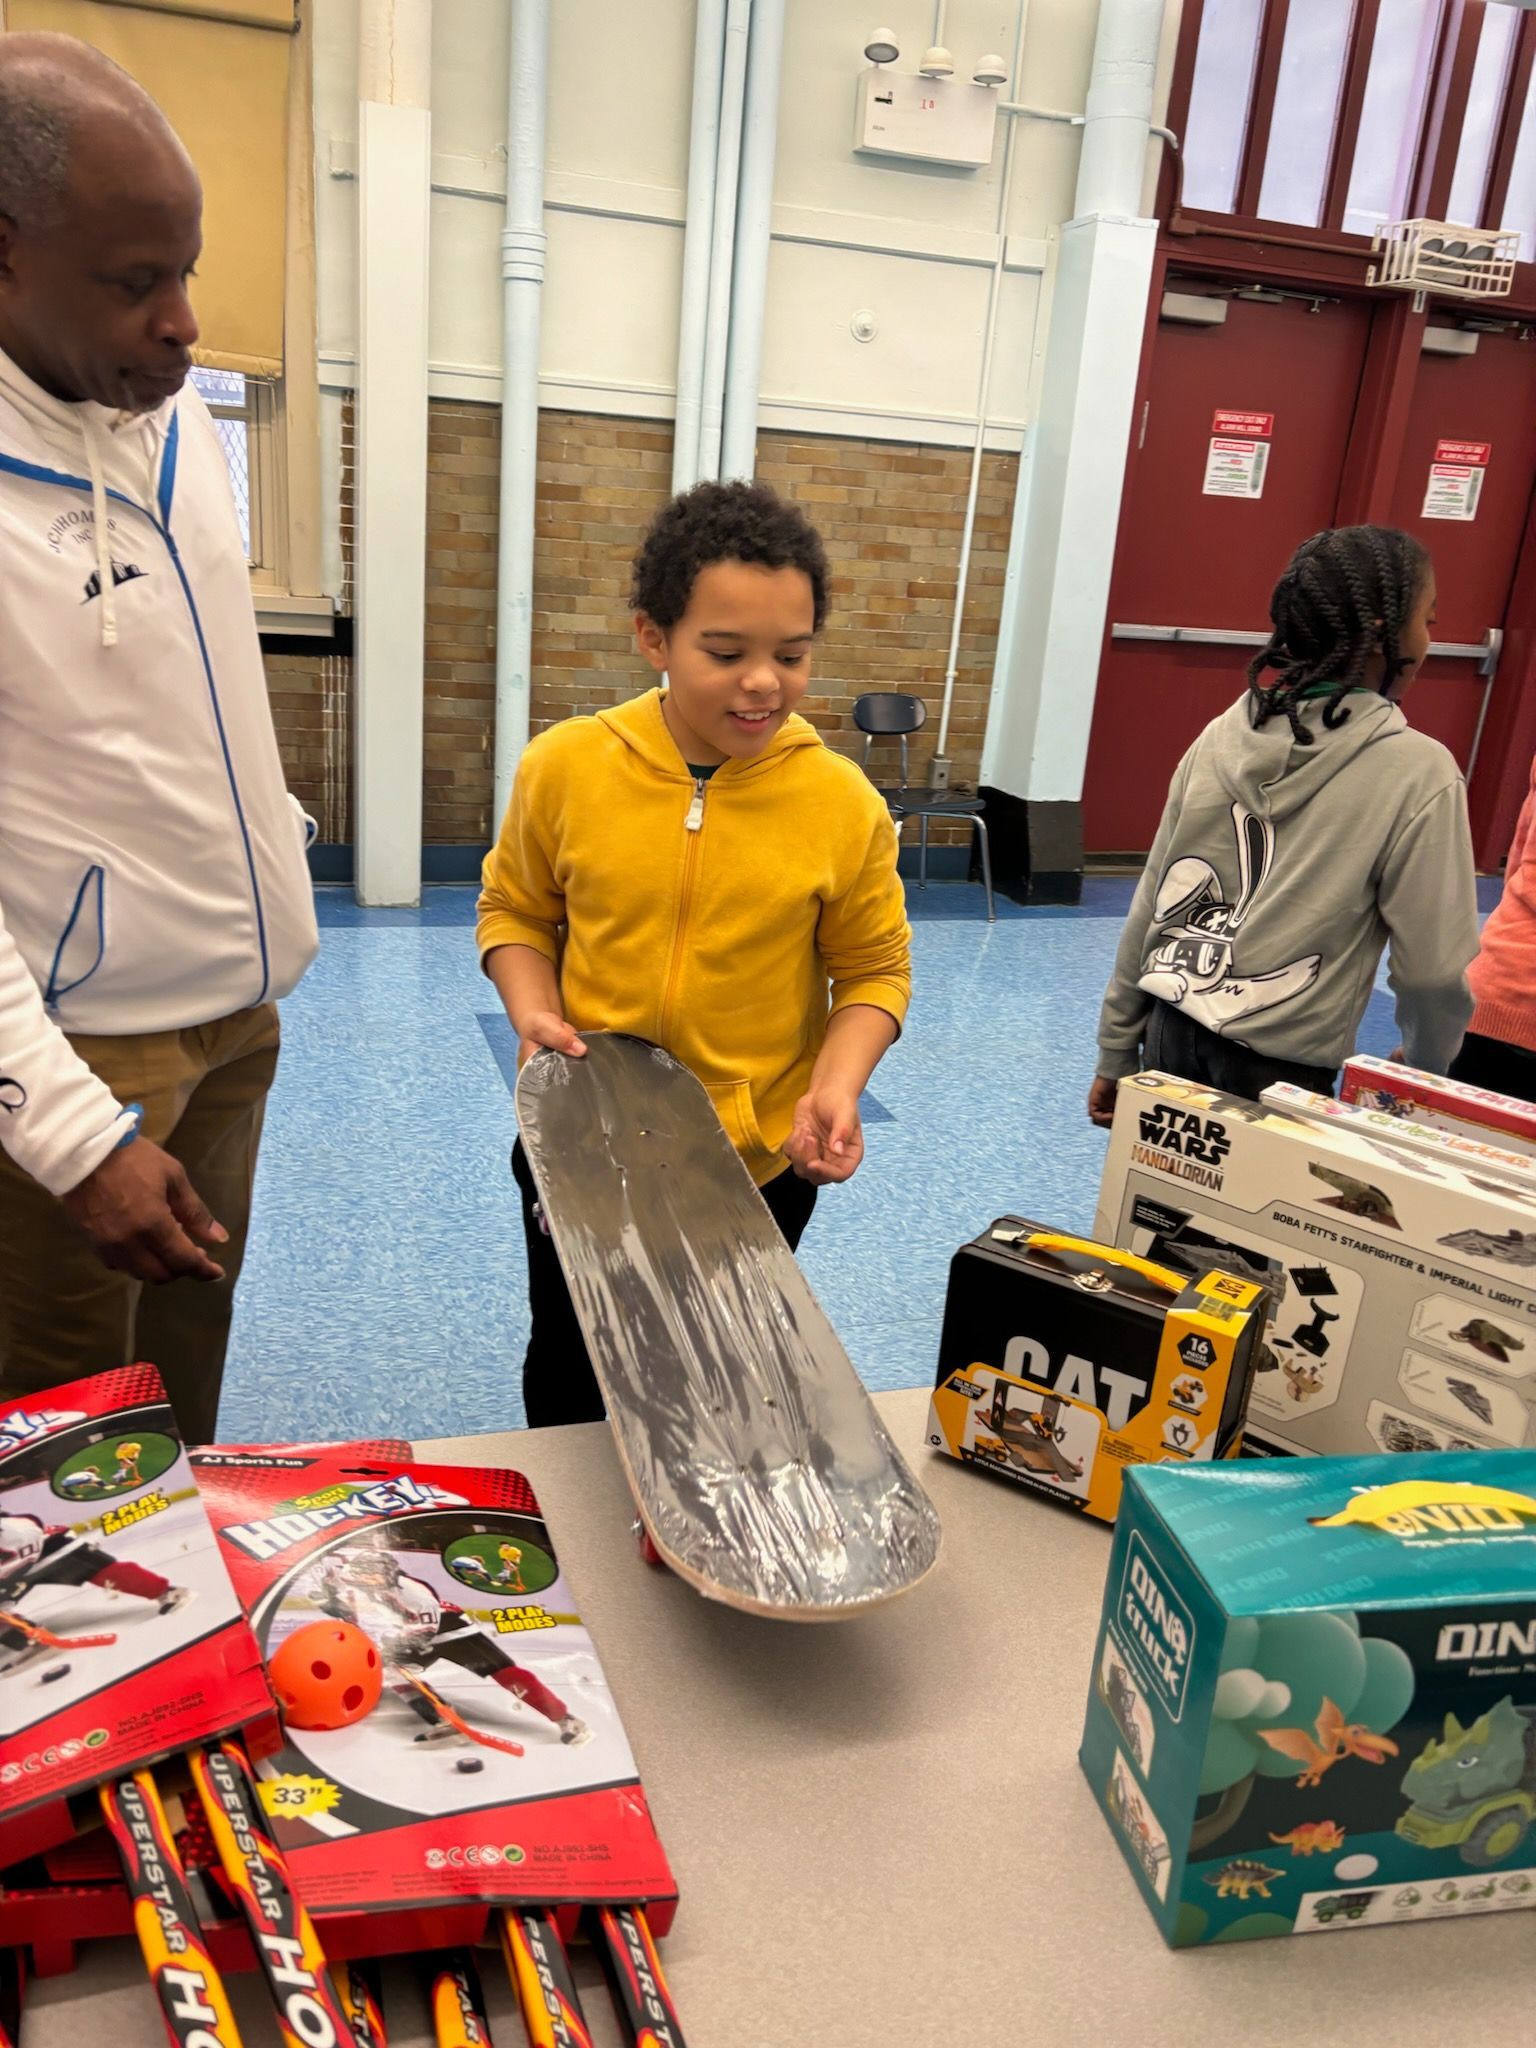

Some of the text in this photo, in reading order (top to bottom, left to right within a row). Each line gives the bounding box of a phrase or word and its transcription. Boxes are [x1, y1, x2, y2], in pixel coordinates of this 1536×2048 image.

[1138, 1119, 1230, 1166] WARS
[1139, 1103, 1232, 1148] STAR
[1130, 1144, 1225, 1192] MANDALORIAN
[1272, 1211, 1301, 1230] BOBA
[1303, 1222, 1338, 1242] FETT'S
[1417, 1263, 1426, 1275] &
[1429, 1267, 1484, 1296] IMPERIAL
[1488, 1288, 1524, 1309] LIGHT
[1189, 1337, 1209, 1352] 16
[1002, 1335, 1148, 1432] CAT
[201, 1455, 303, 1467] AJ Sports Fun
[101, 1491, 161, 1524] 2 PLAY
[103, 1498, 170, 1536] MODES
[220, 1474, 425, 1561] HOCKEY
[294, 1487, 346, 1510] Sport
[492, 1605, 546, 1621] 2 PLAY
[496, 1616, 557, 1634] MODES
[1435, 1619, 1536, 1660] DIN
[116, 1698, 206, 1736] MADE IN CHINA
[532, 1853, 612, 1863] MADE IN CHINA
